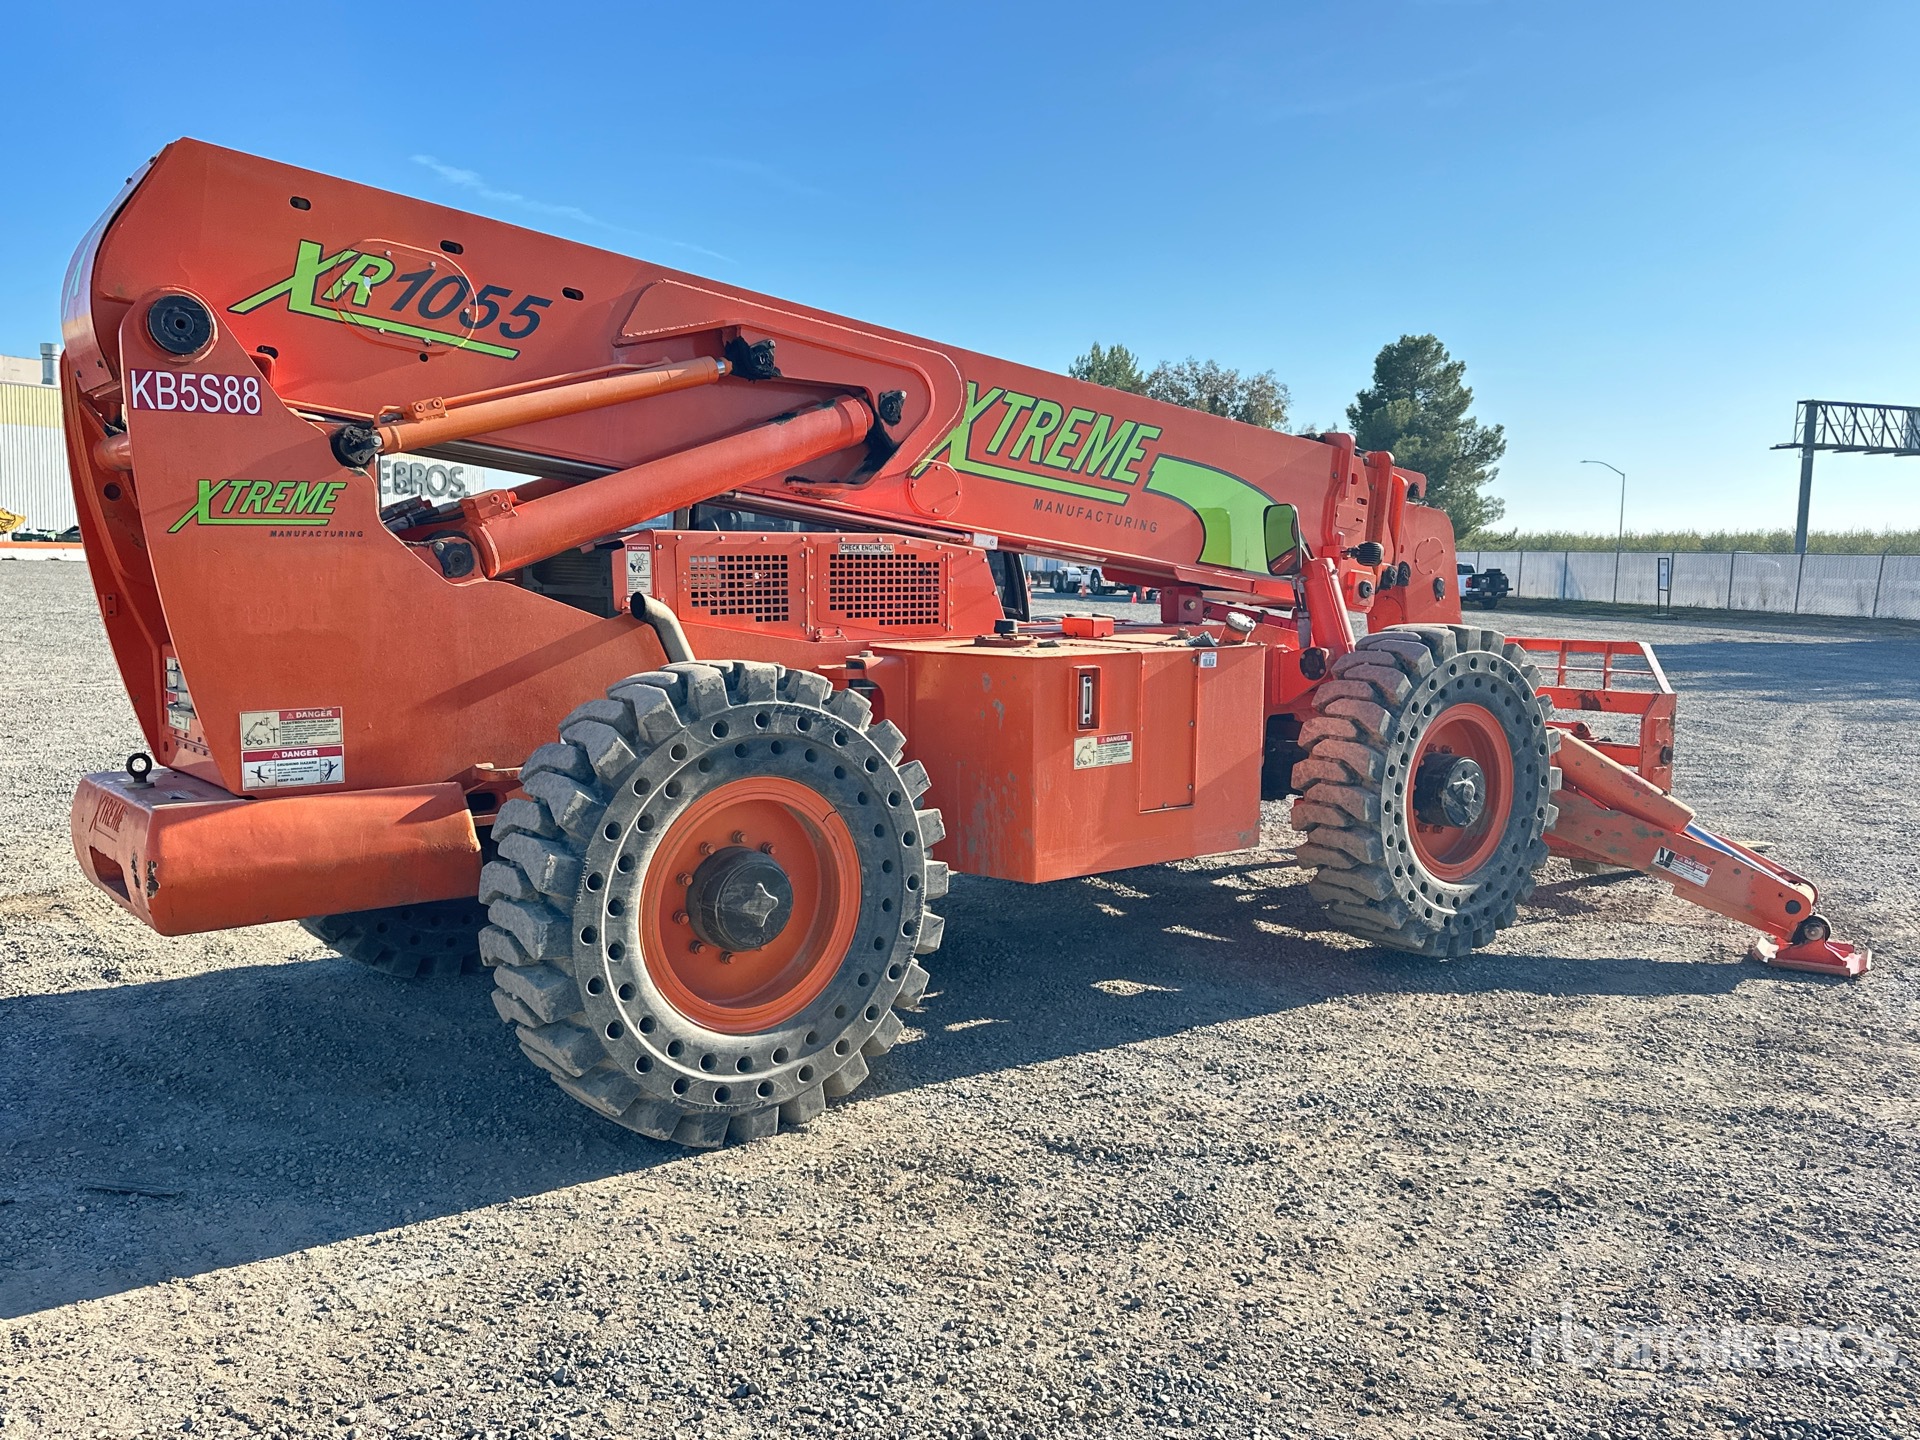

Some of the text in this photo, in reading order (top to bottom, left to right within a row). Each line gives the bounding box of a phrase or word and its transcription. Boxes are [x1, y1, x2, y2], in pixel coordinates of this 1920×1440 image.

[130, 371, 261, 414] KB5S88
[911, 381, 1162, 505] XTREME
[167, 479, 347, 534] XTREME
[1033, 498, 1159, 534] MANUFACTURING
[269, 529, 364, 538] MANUFACTURING
[296, 710, 333, 719] DANGER
[281, 750, 319, 758] DANGER
